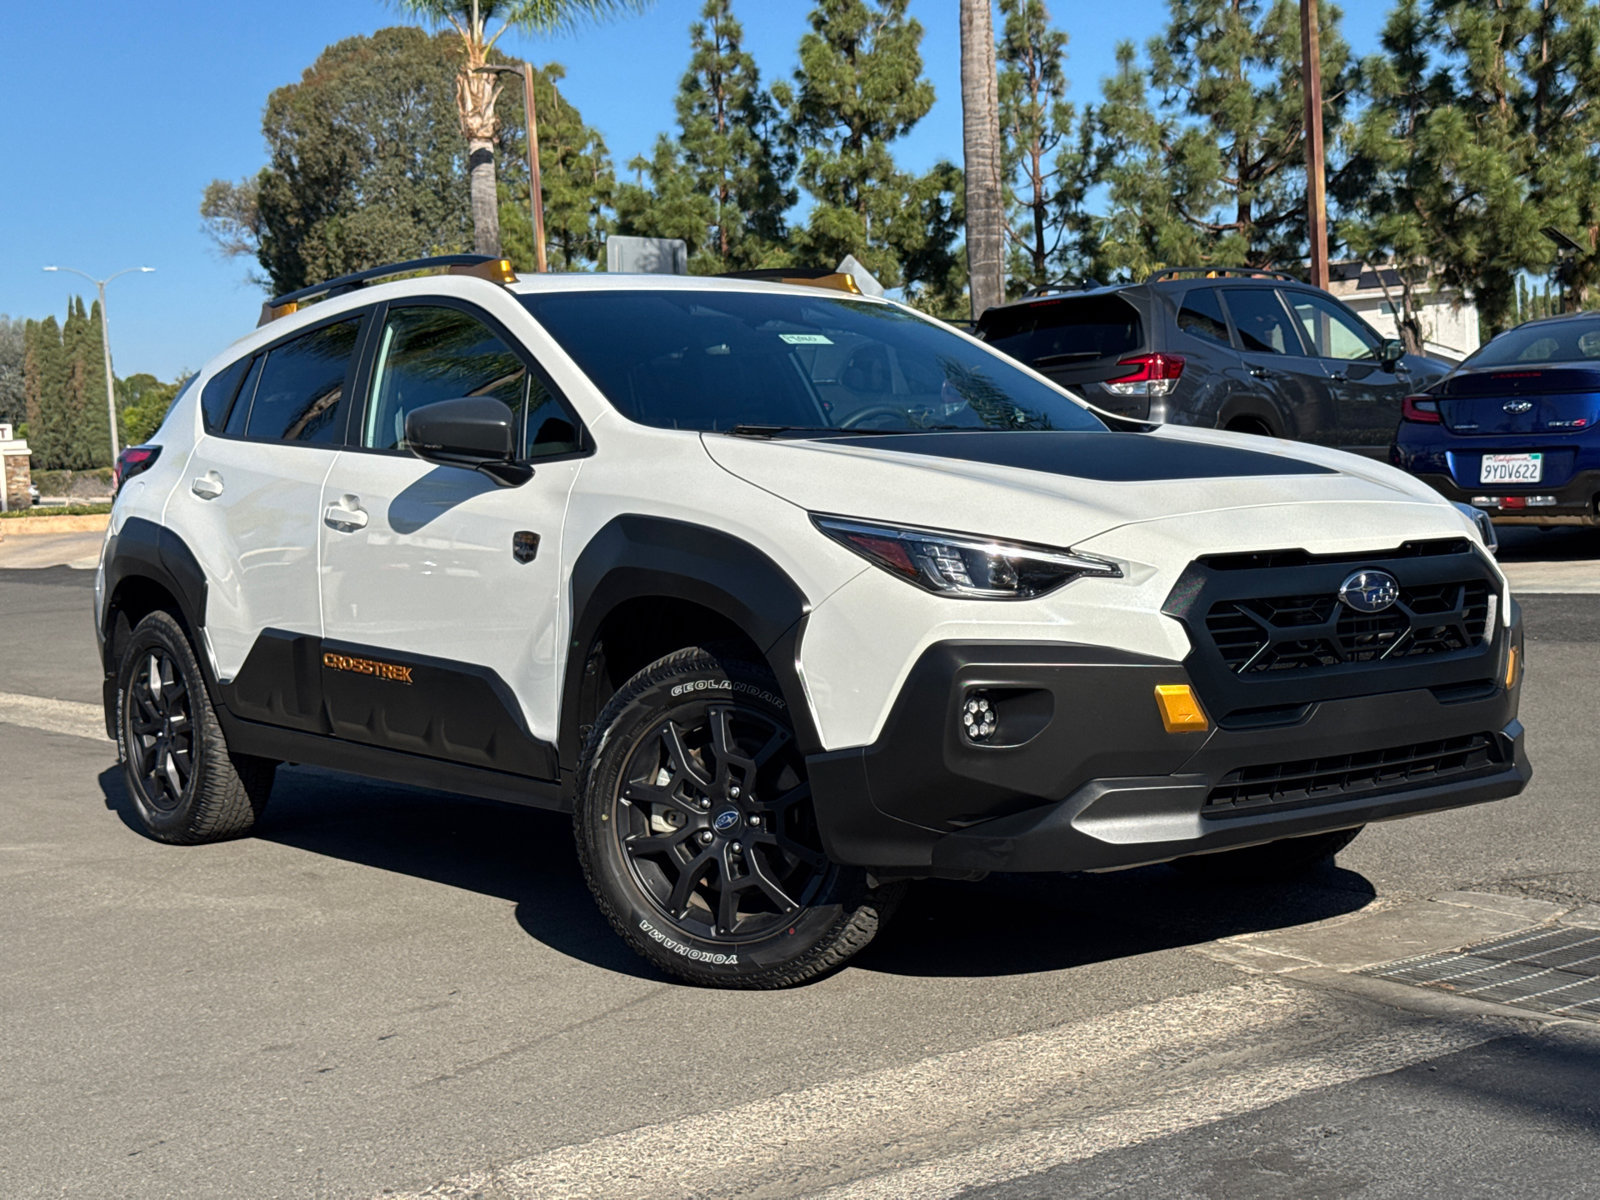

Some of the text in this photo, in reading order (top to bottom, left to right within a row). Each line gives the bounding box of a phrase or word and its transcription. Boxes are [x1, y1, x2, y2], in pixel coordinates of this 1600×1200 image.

[1484, 464, 1537, 479] 9YDV622
[323, 652, 413, 683] CROSSTREK
[671, 680, 785, 709] GEOLANDAR
[639, 920, 739, 964] YOKOHAMA
